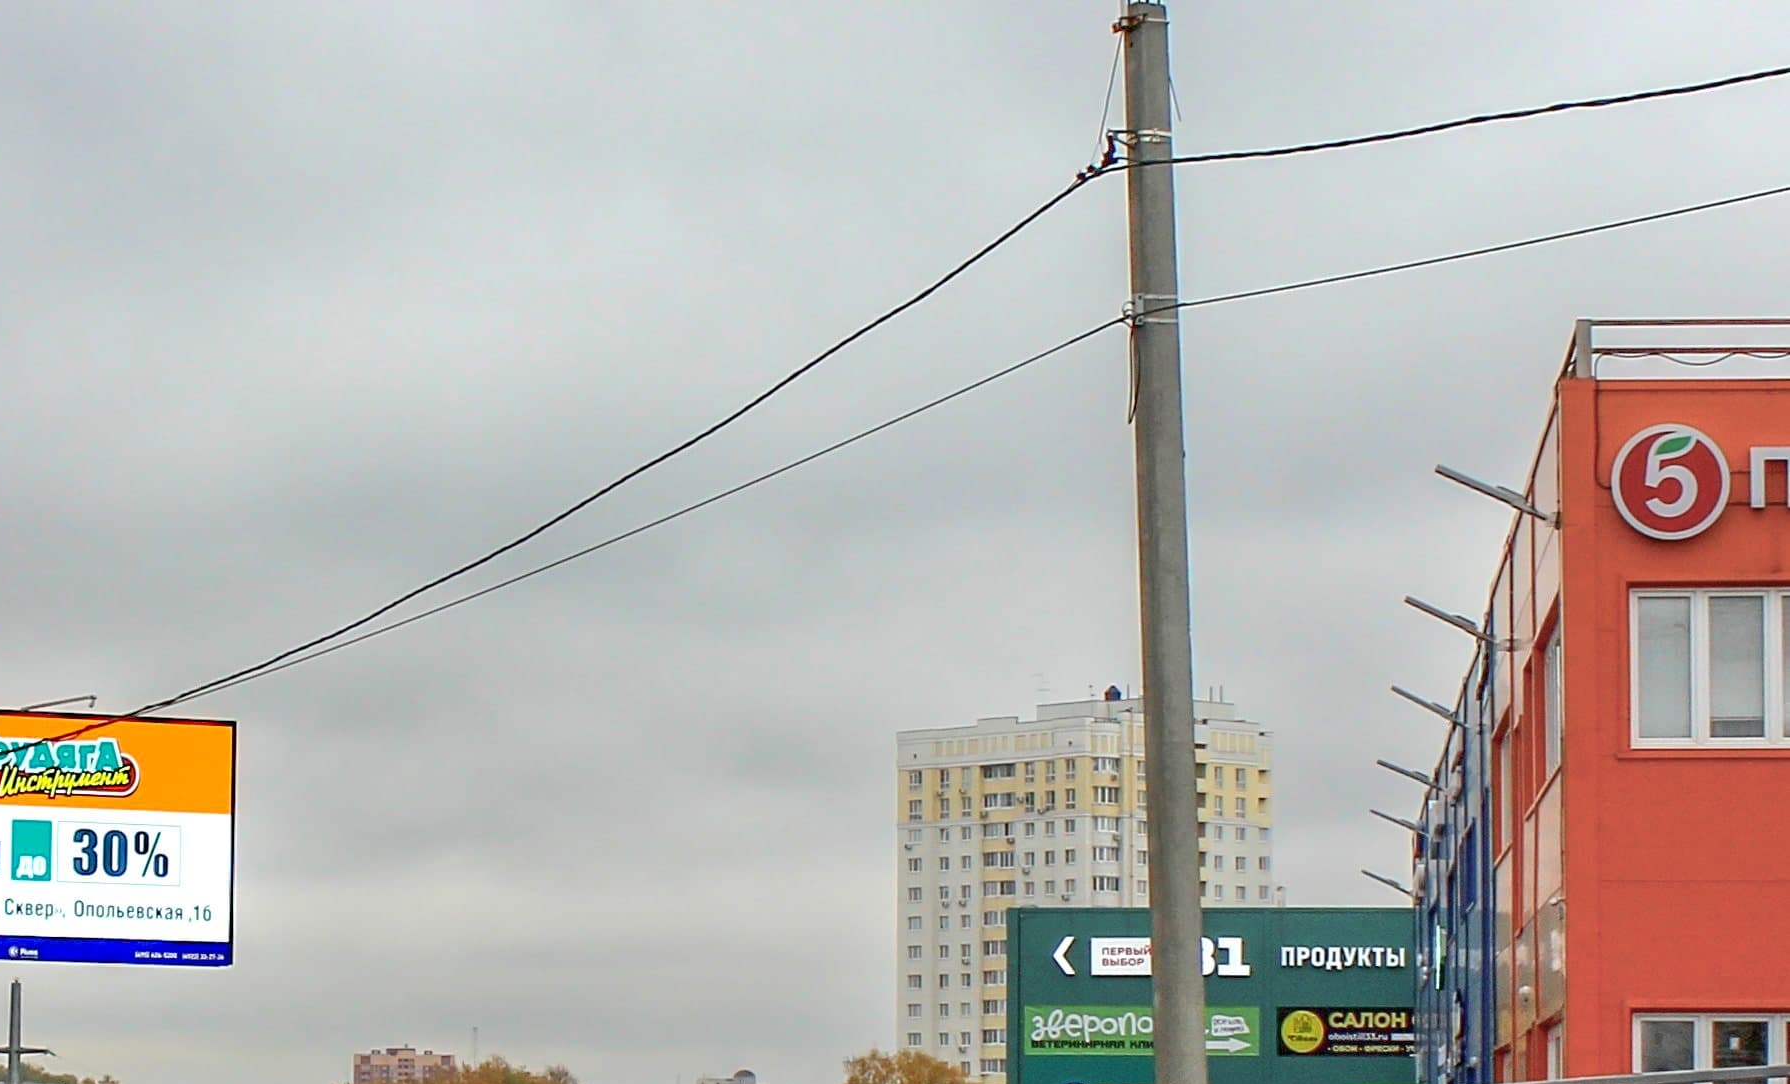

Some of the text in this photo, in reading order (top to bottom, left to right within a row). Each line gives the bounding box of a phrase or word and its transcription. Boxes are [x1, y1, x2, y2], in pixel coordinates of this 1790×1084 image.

[73, 828, 169, 877] 30%
[74, 900, 184, 920] Опольевская
[1101, 945, 1153, 956] ПЕРВЫЙ
[1281, 946, 1406, 970] ПРОДУКТЫ
[1101, 957, 1145, 967] ВЫБОР
[1328, 1011, 1407, 1029] САЛОН
